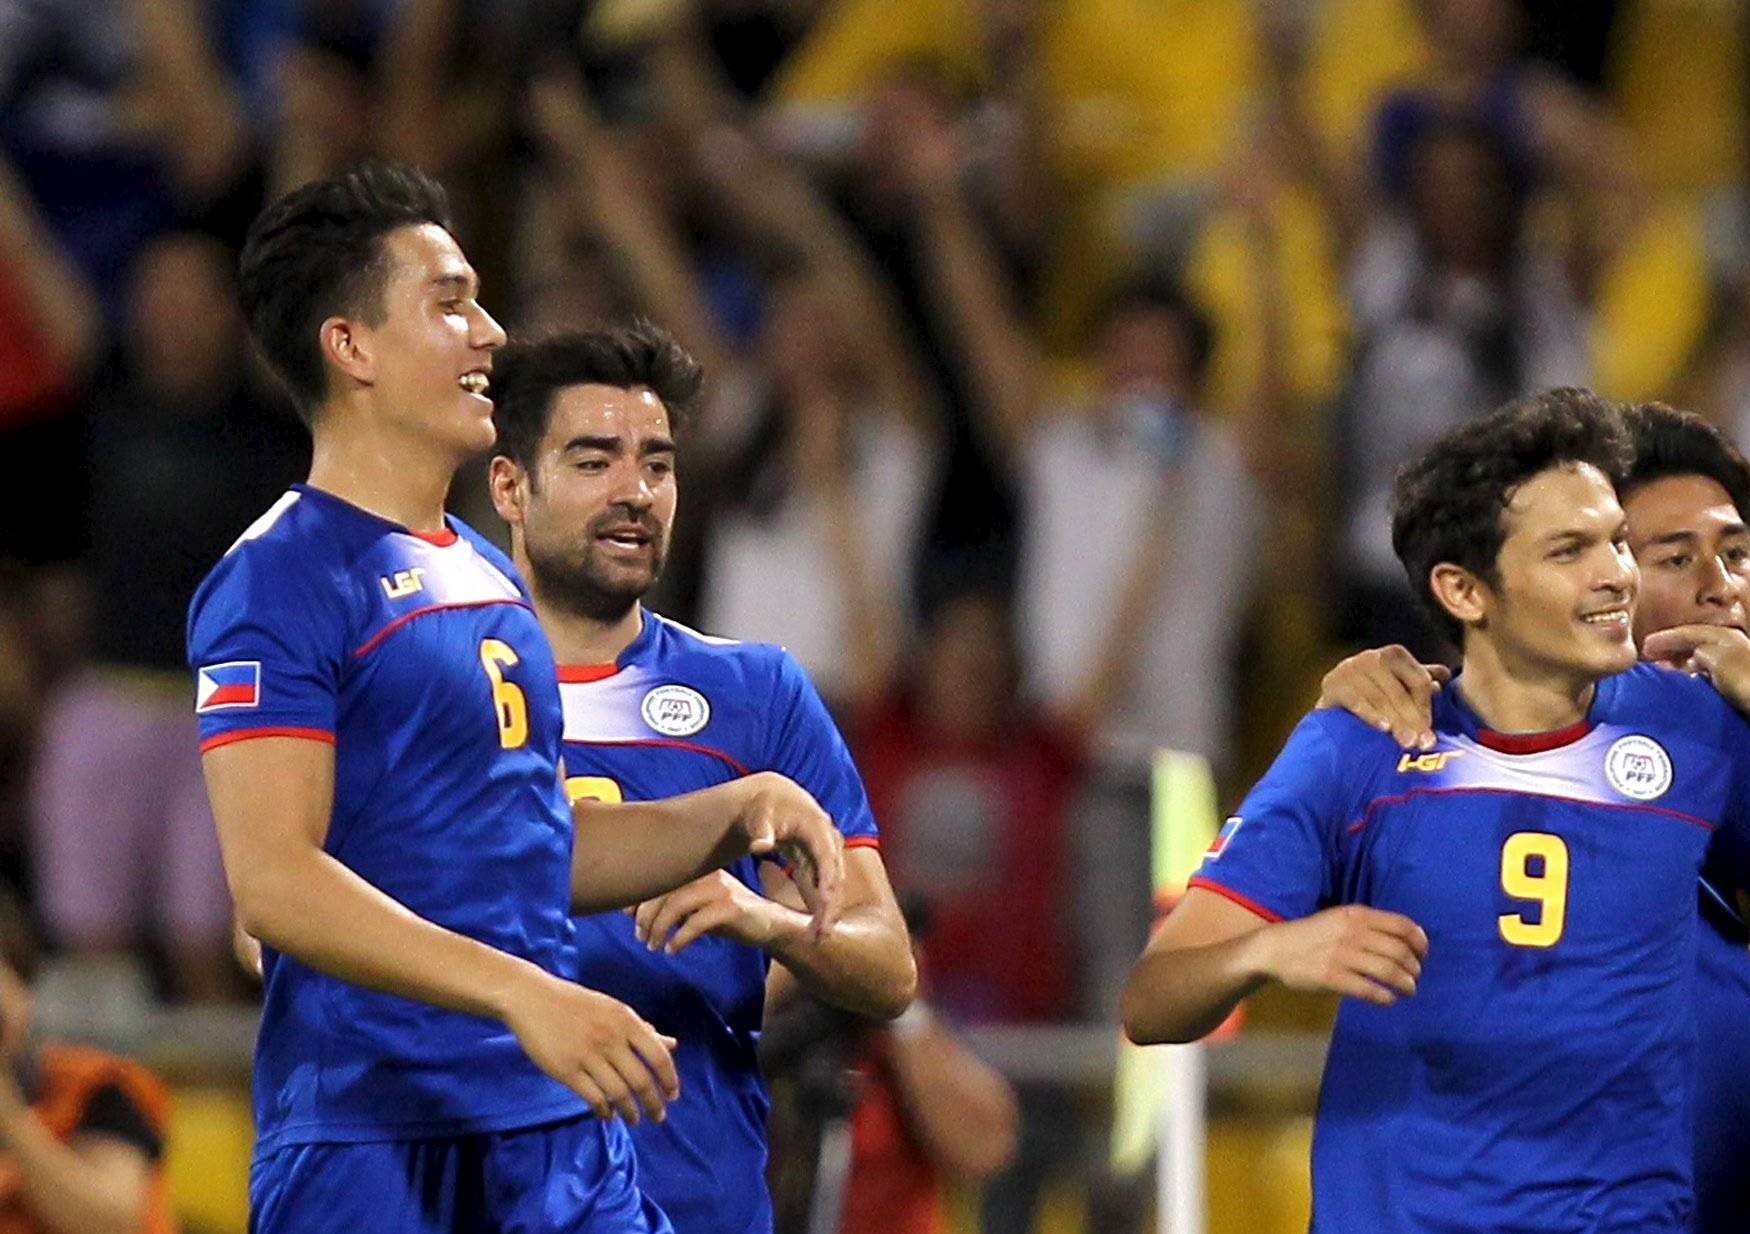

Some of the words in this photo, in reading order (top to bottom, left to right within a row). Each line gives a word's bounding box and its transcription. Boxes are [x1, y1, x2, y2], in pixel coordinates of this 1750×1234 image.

[479, 638, 527, 748] 6
[1625, 770, 1656, 783] PFF
[1498, 831, 1569, 946] 9
